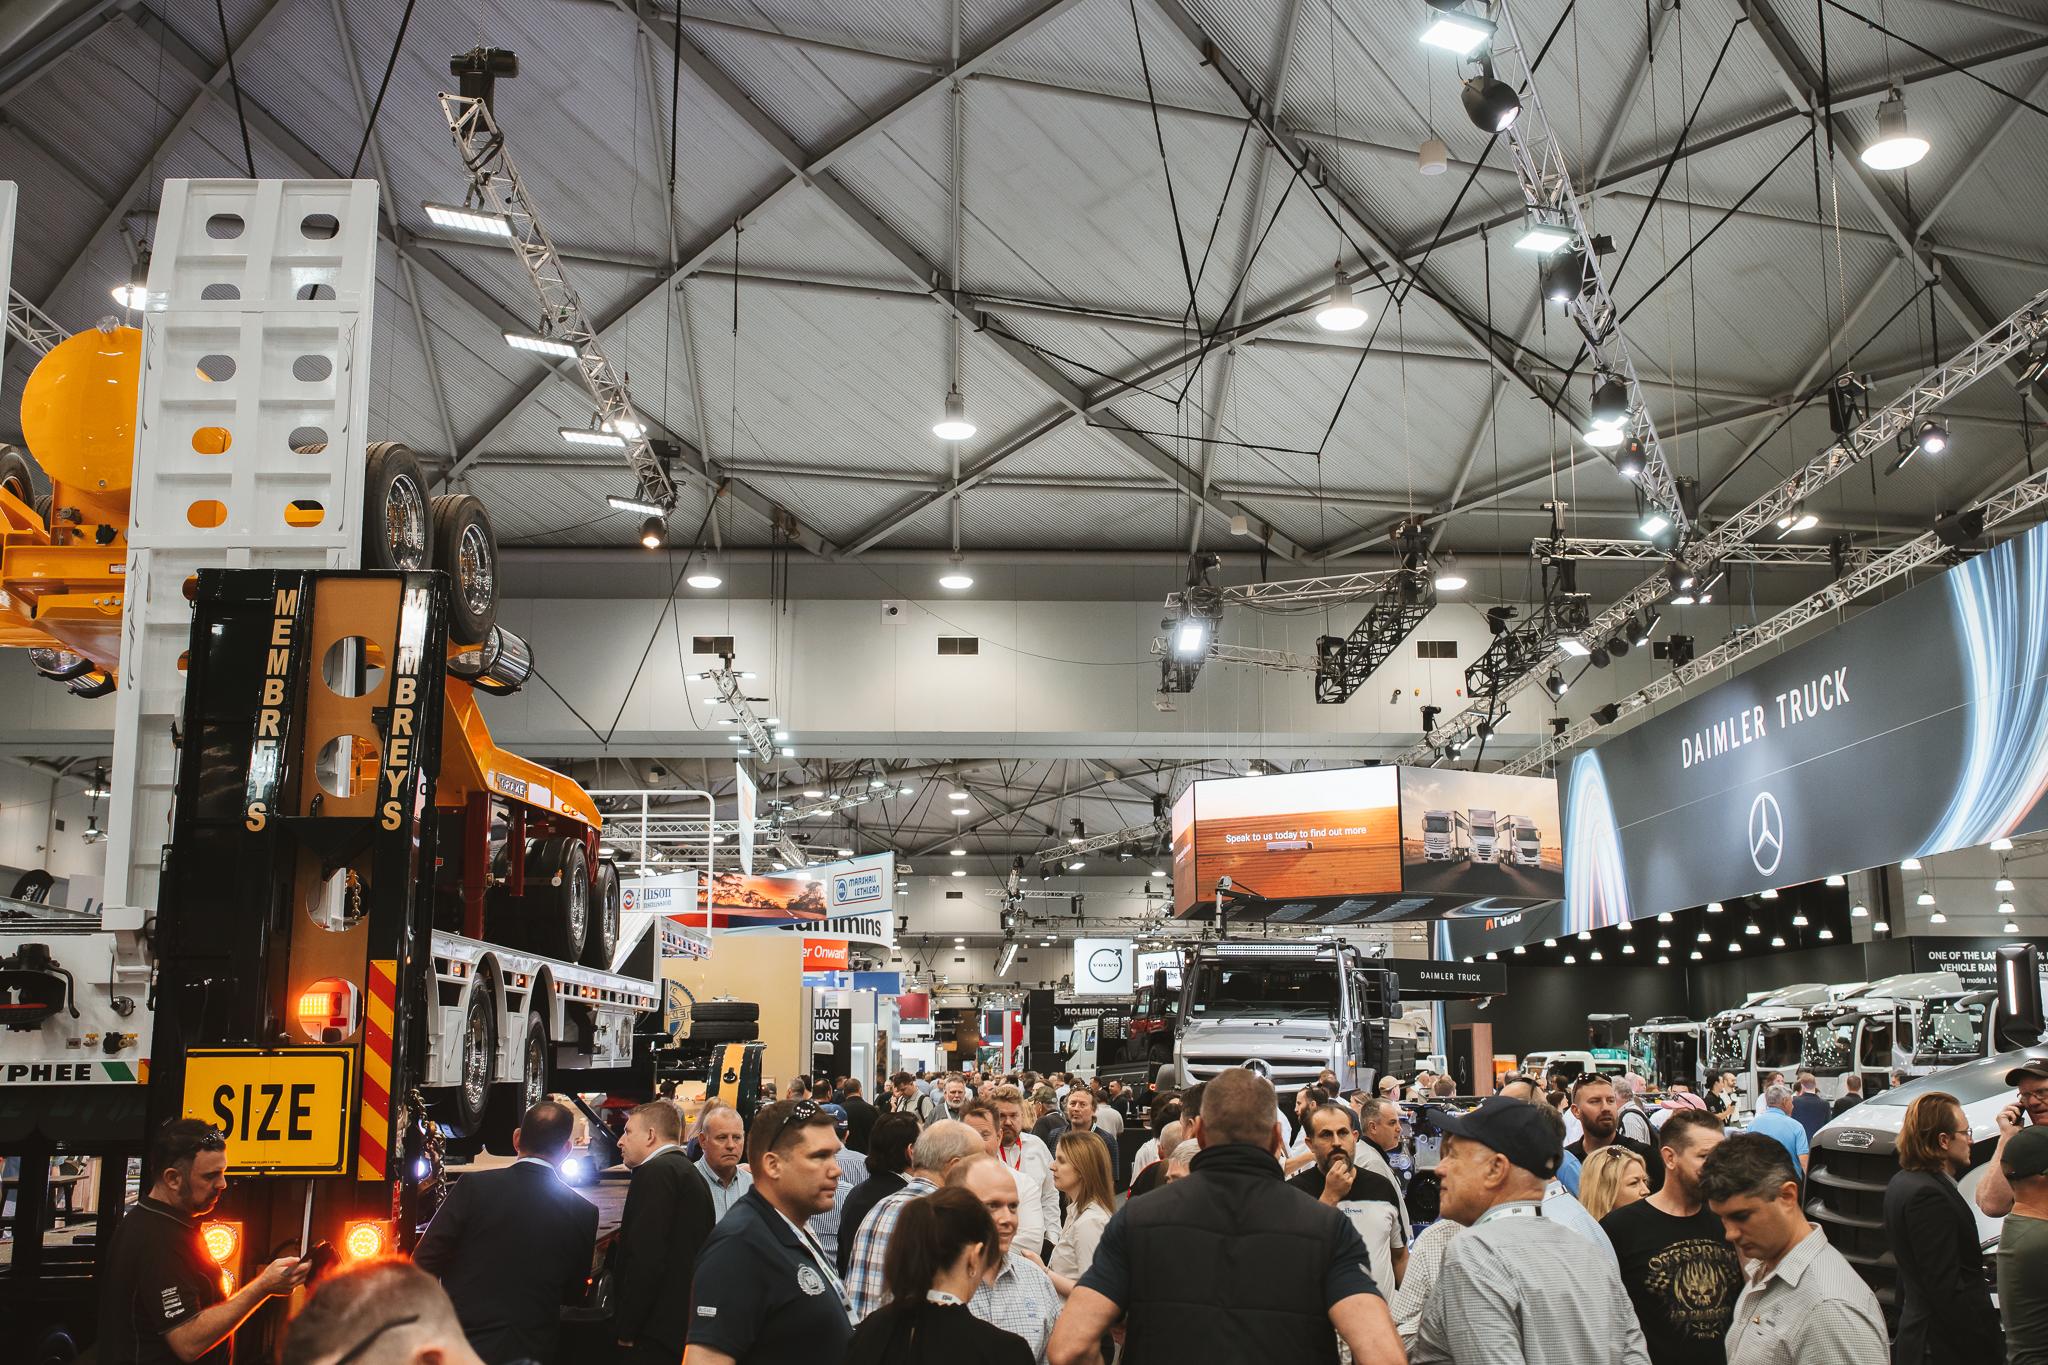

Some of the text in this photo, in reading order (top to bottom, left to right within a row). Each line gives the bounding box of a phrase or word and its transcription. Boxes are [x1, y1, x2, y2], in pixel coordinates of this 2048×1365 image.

[381, 588, 428, 831] MMBREYS
[1681, 666, 1850, 769] DAIMLER TRUCK
[1226, 826, 1367, 844] Speak to us today to find out more
[848, 875, 877, 888] MARSHALL
[778, 916, 881, 938] ummins
[802, 947, 812, 957] er
[1928, 951, 1948, 960] ONE
[1948, 951, 1961, 960] OF
[1962, 951, 1980, 960] THE
[1169, 958, 1185, 967] truk
[1940, 963, 1997, 972] VEHICLE RAN
[1420, 971, 1481, 982] DAIMLER TRUCK
[814, 1009, 840, 1018] LIAN
[1064, 1007, 1118, 1016] HOLMWO
[815, 1018, 840, 1030] ING
[815, 1032, 840, 1041] ORK
[0, 1063, 92, 1082] PHEE
[212, 1083, 316, 1141] SIZE
